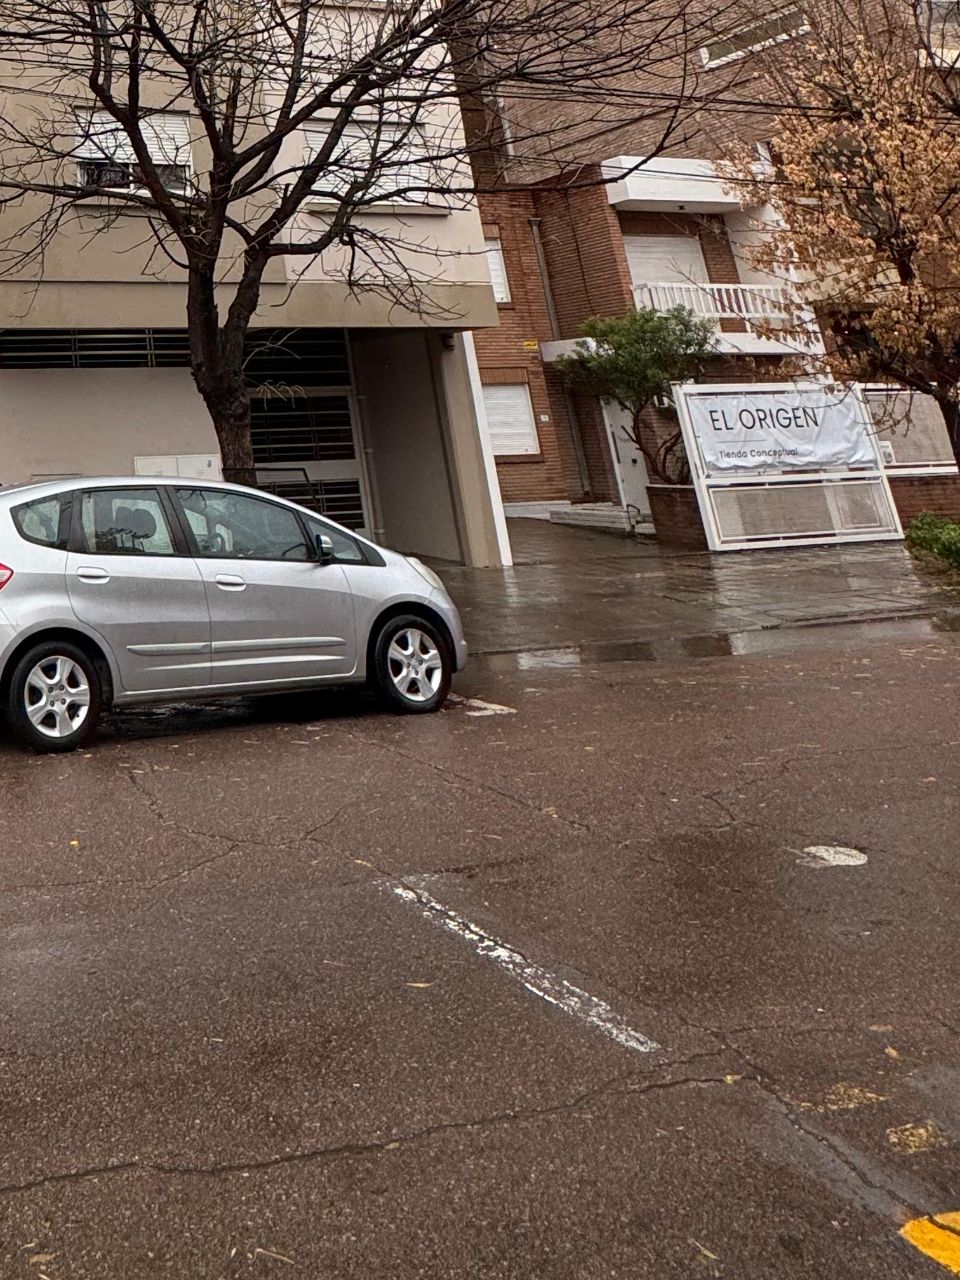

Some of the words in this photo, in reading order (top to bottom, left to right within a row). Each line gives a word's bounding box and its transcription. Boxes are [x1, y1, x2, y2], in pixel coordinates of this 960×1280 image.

[709, 409, 734, 431] EL
[738, 406, 819, 430] ORIGEN
[719, 449, 748, 459] Tienda
[749, 447, 798, 458] Conceptual
